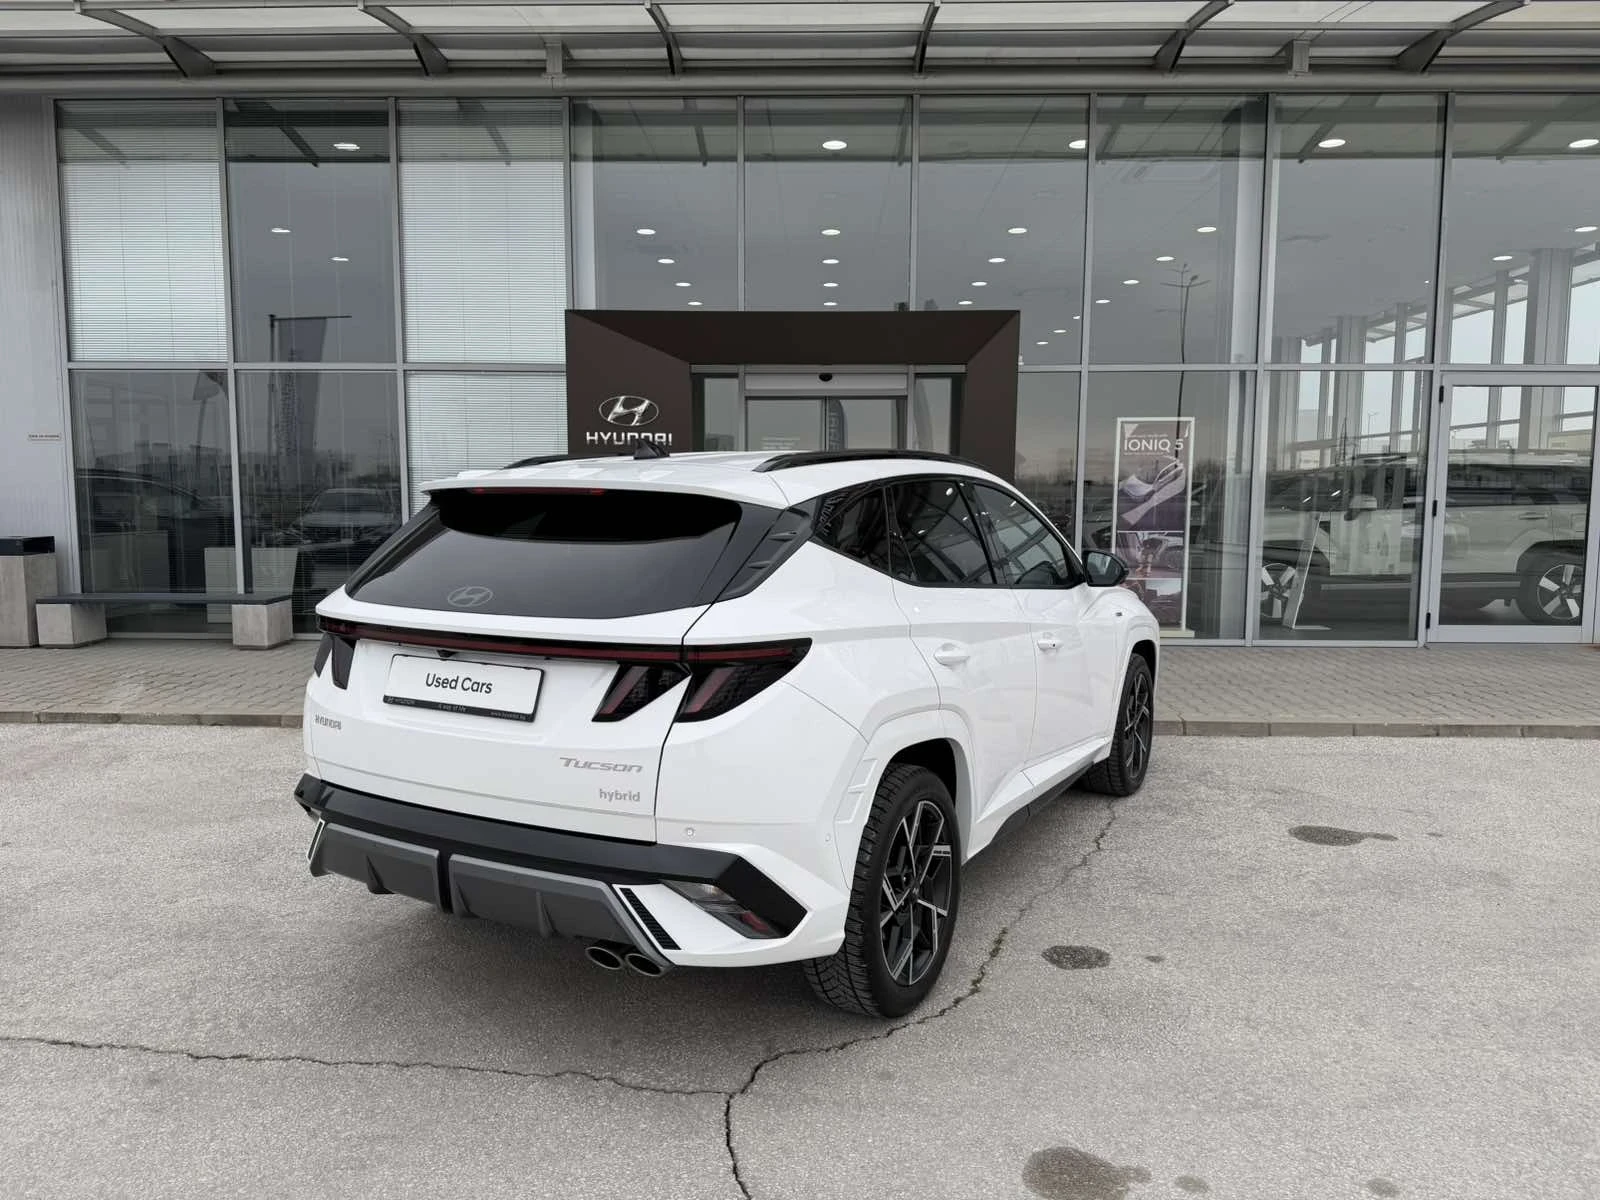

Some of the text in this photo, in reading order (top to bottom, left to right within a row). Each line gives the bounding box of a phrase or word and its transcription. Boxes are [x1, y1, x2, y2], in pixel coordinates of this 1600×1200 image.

[586, 431, 673, 446] HYUNDAI
[1124, 438, 1184, 453] IONIQ 5
[425, 672, 493, 694] Used Cars
[599, 788, 641, 802] hybrid
